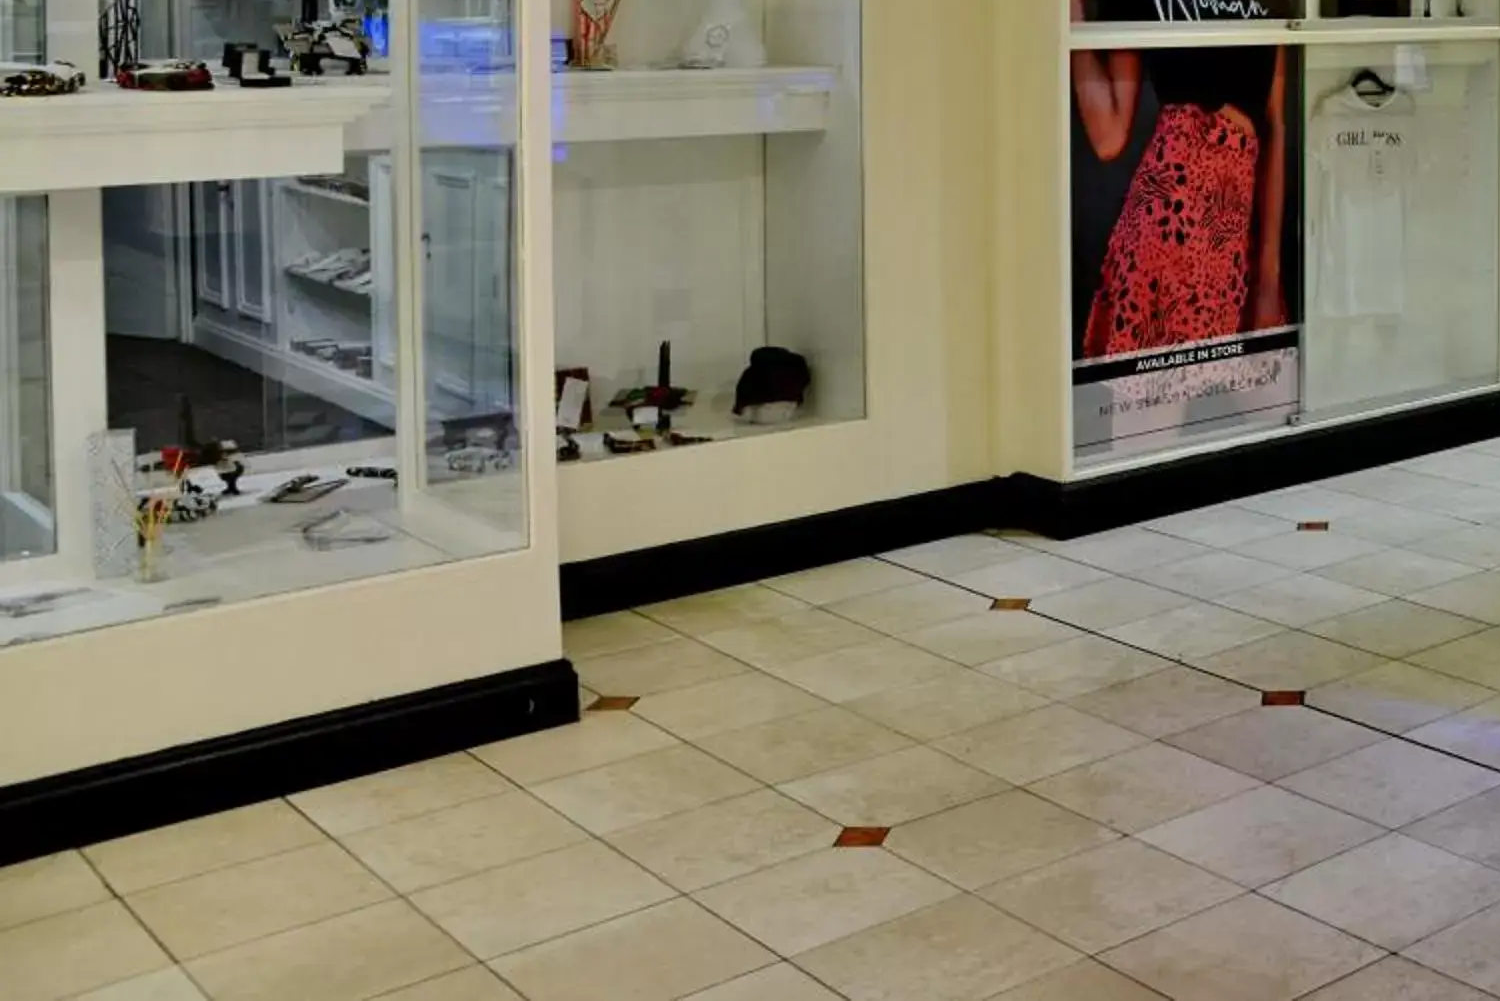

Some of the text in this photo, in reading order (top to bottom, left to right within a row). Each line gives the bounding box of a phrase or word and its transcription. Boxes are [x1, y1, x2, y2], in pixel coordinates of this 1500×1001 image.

[1337, 129, 1368, 146] GIRL
[1136, 343, 1244, 372] AVAILABLE IN STORE
[1099, 401, 1131, 416] NEW
